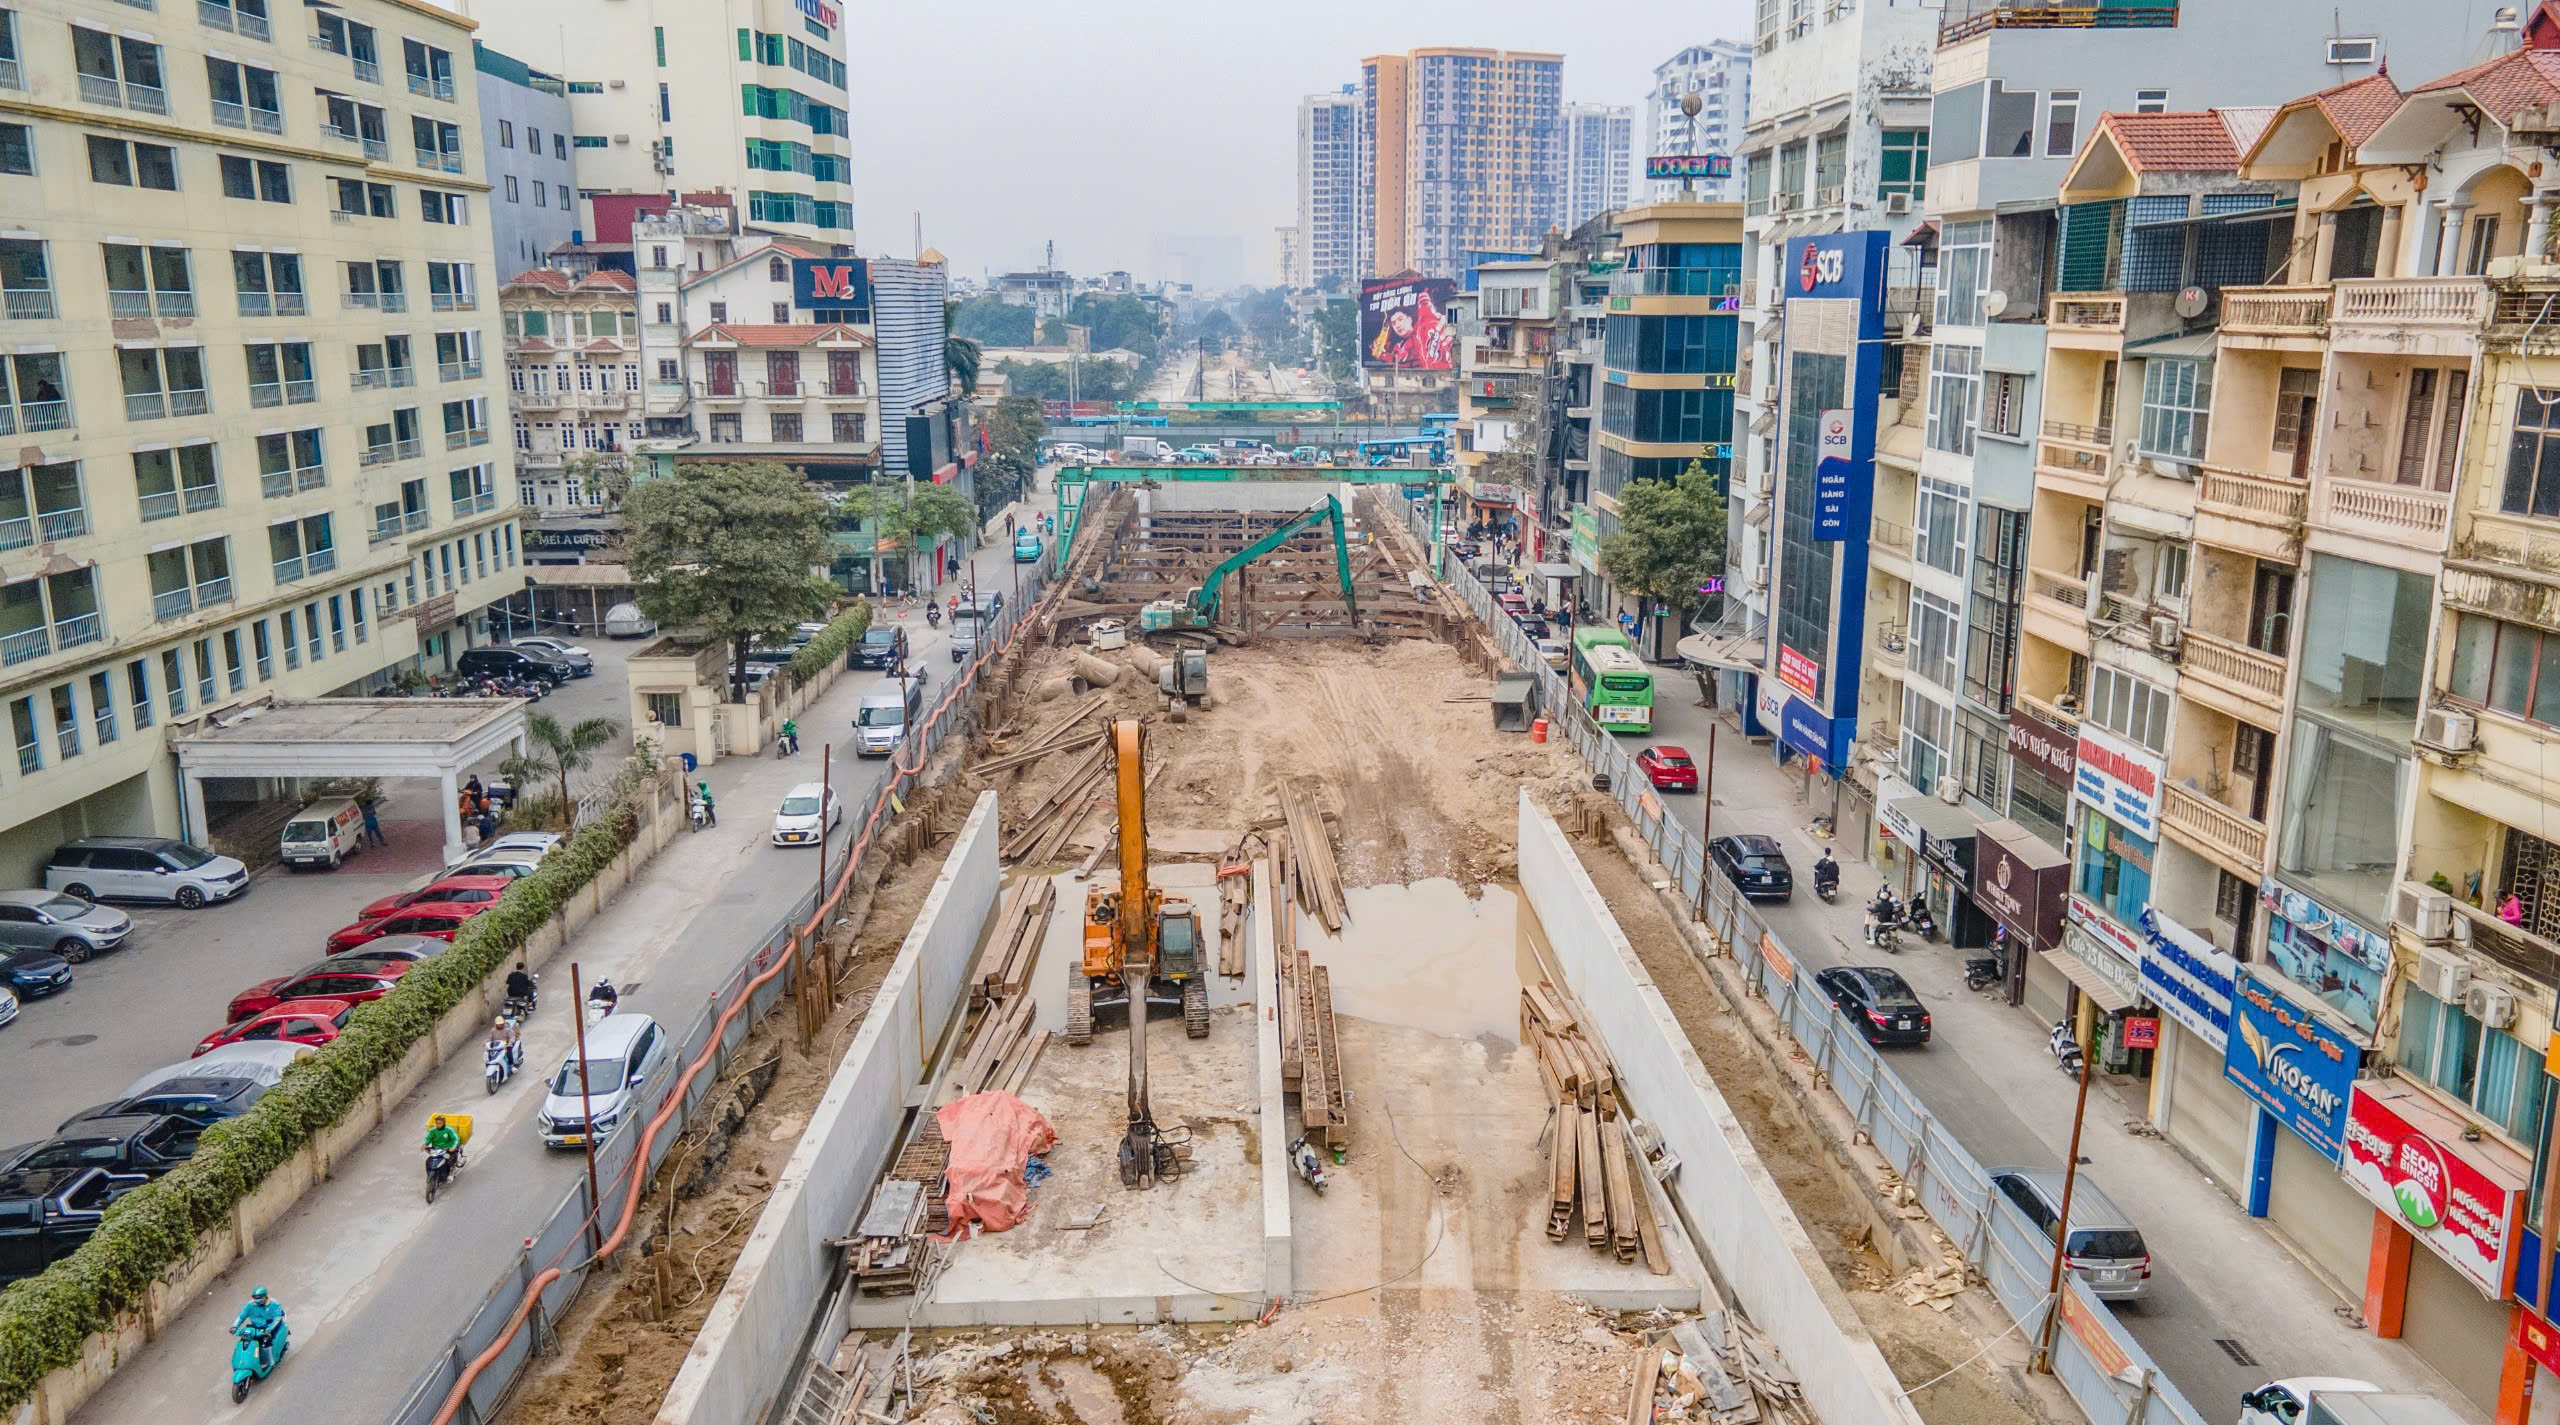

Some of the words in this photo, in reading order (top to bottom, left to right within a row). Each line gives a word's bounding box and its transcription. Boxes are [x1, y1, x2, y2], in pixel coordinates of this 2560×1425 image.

[1816, 249, 1844, 283] SCB
[810, 266, 856, 300] M2
[1824, 435, 1847, 445] SCB
[1822, 474, 1845, 484] NGÂN
[1821, 488, 1844, 499] HÀNG
[1825, 505, 1839, 513] SÀI
[1822, 517, 1840, 527] GÒN
[1767, 696, 1778, 716] SCB
[2086, 943, 2097, 966] 35
[2098, 951, 2114, 979] Kim
[2130, 1027, 2155, 1038] 35
[2260, 1035, 2334, 1114] VIKOSAN
[2311, 1105, 2331, 1128] đông
[2401, 1143, 2439, 1181] SEOR
[2400, 1159, 2438, 1193] BINGSU
